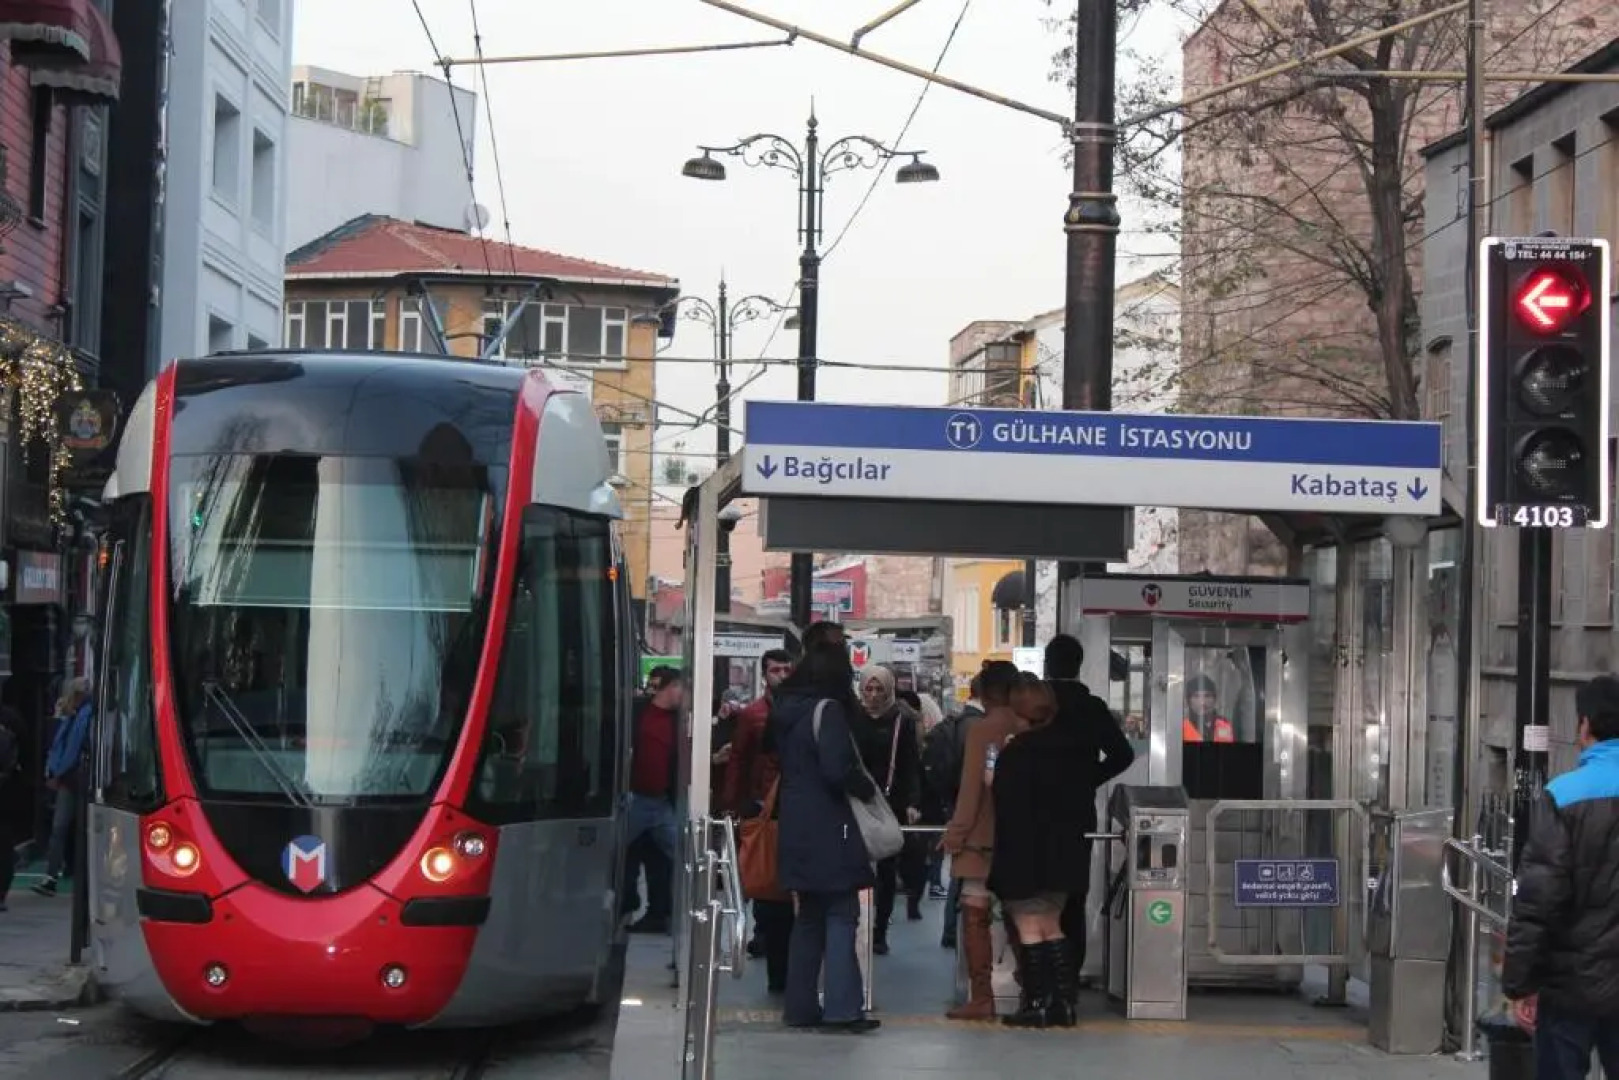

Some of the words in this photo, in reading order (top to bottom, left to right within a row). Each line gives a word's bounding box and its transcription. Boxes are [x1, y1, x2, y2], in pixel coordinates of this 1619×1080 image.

[951, 421, 976, 442] T1
[992, 419, 1106, 447] GÜLHANE
[1120, 423, 1252, 450] İSTASYONU
[784, 456, 891, 484] Bağcılar
[1291, 473, 1398, 503] Kabataş
[1514, 505, 1573, 527] 4103
[1188, 584, 1253, 599] GÜVENLİK
